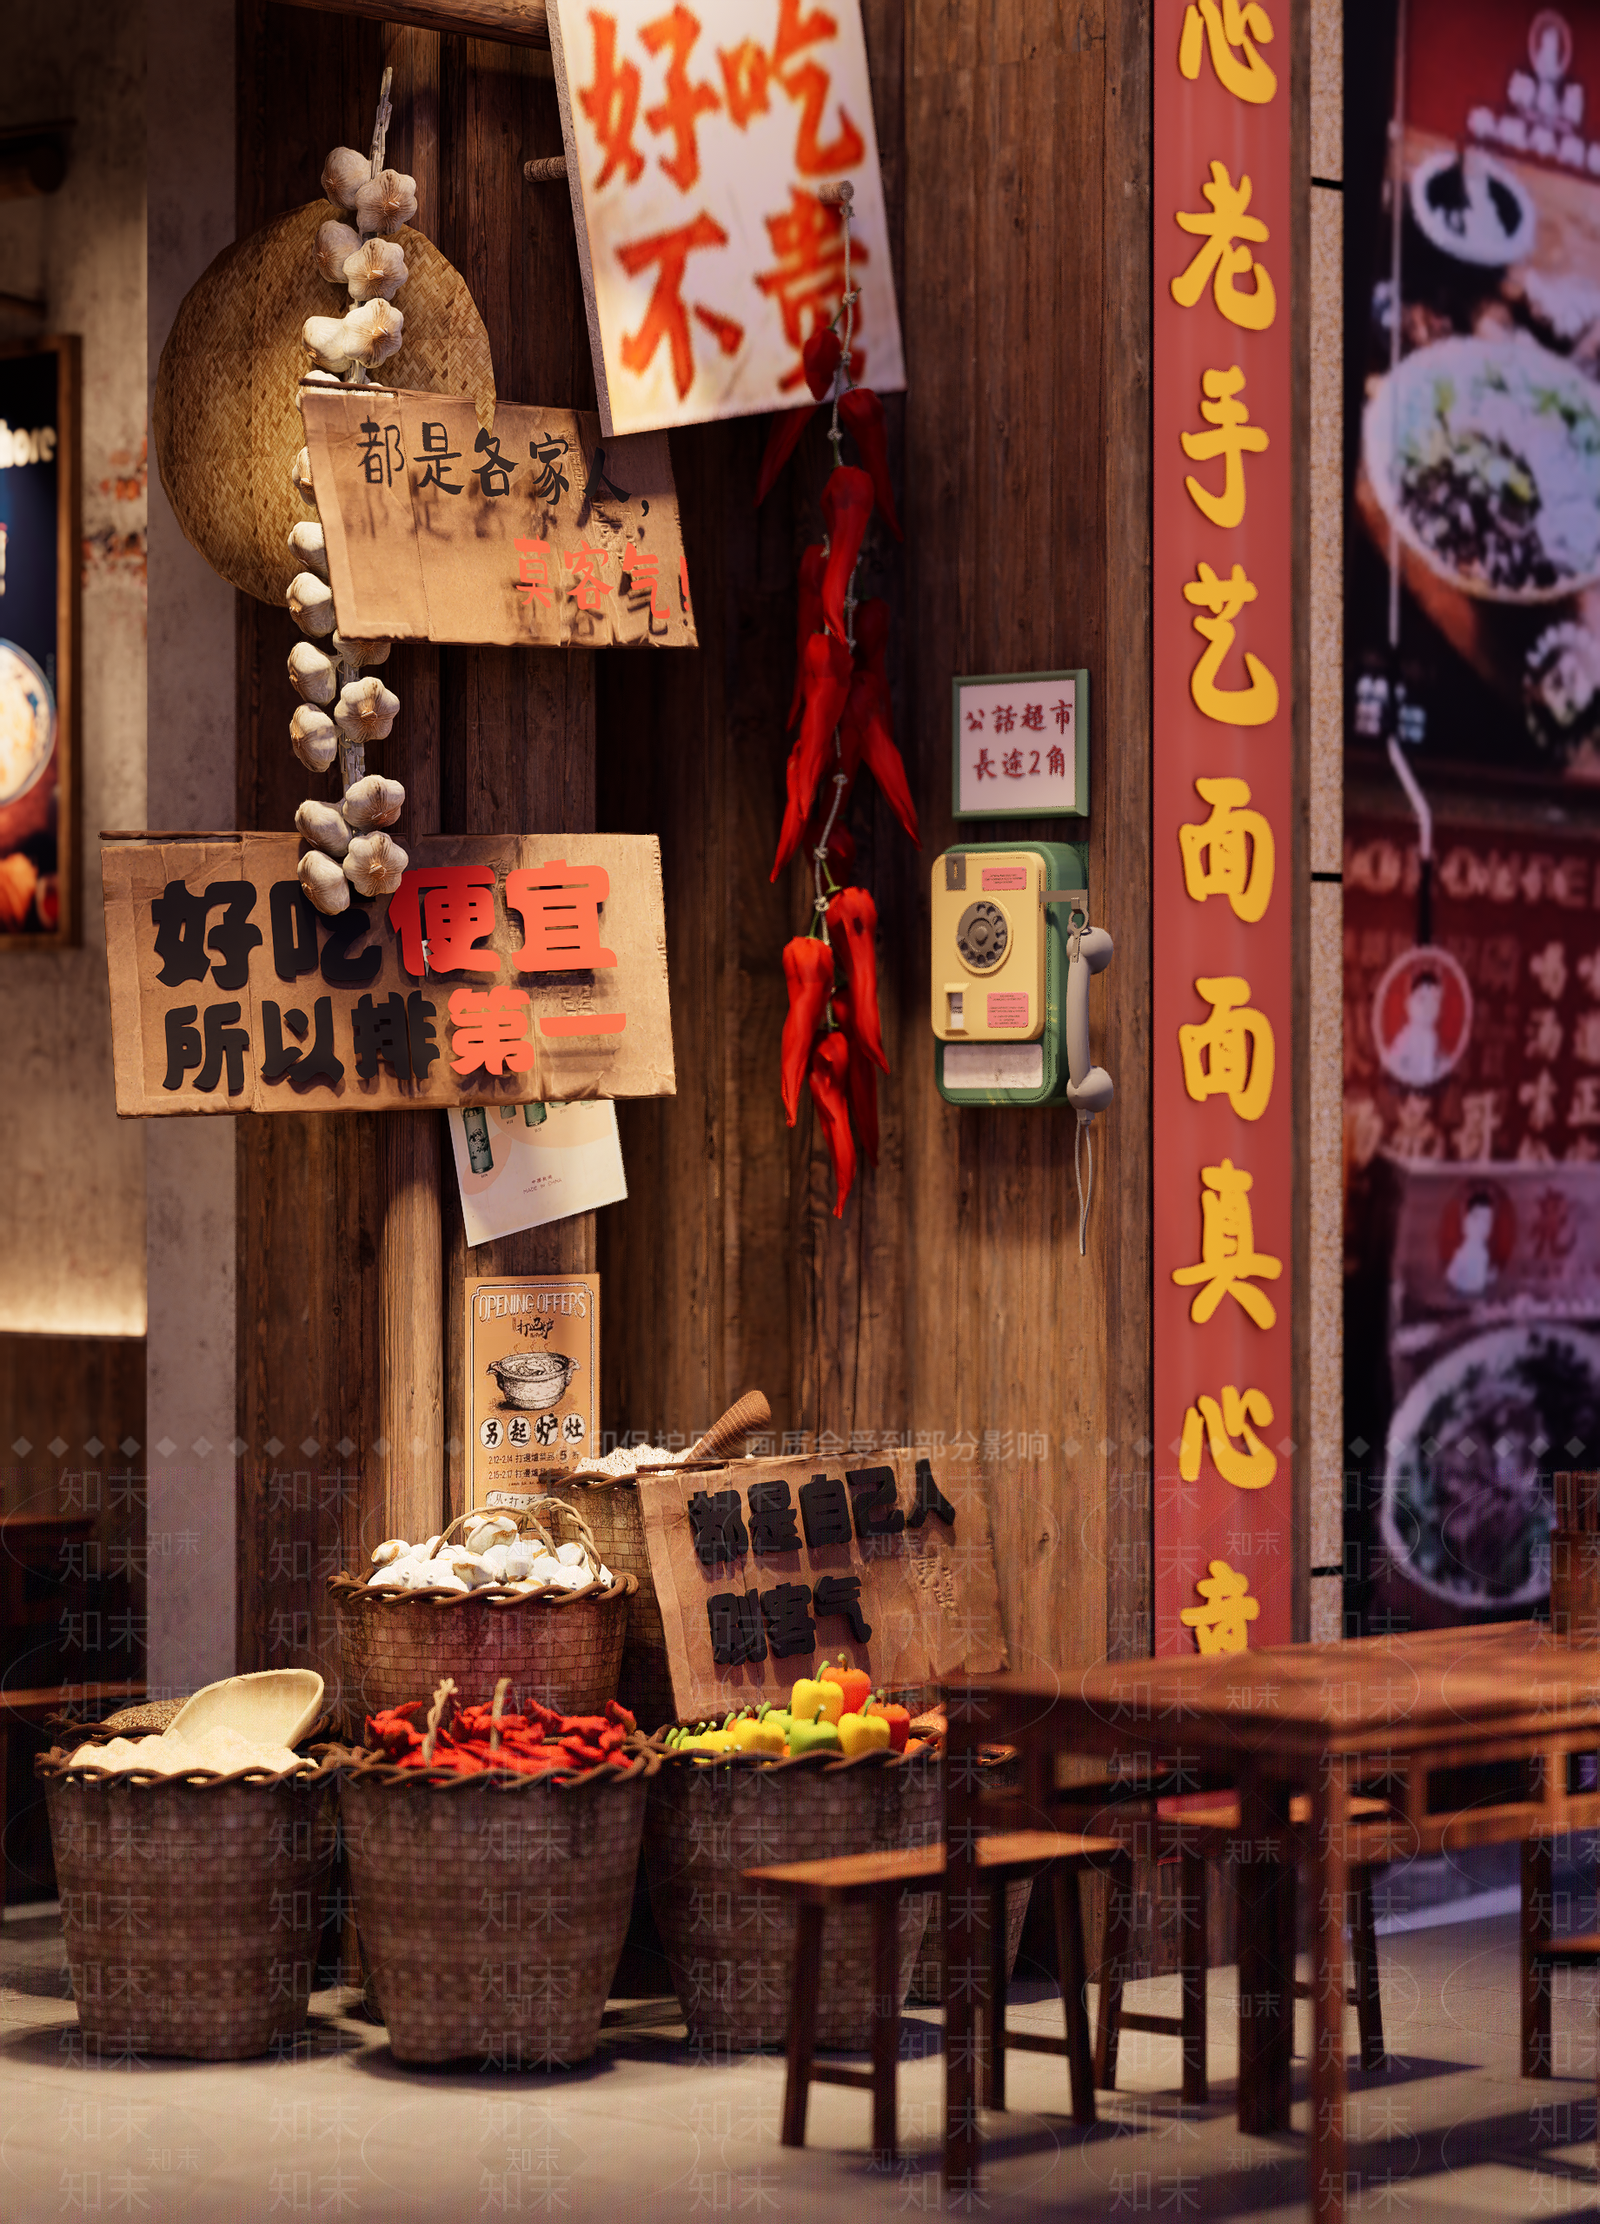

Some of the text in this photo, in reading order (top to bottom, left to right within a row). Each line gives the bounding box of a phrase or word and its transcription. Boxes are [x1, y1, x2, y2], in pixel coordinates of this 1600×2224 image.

[577, 0, 865, 193] 好吃
[615, 187, 869, 401] 不贵
[964, 699, 1073, 735] 公話超市
[152, 858, 618, 989] 好吃便宜
[162, 987, 626, 1090] 所以排第一
[478, 1292, 587, 1322] OPENING OFFERS
[485, 1412, 584, 1446] 另起炉灶
[688, 1458, 955, 1566] 都是自己人
